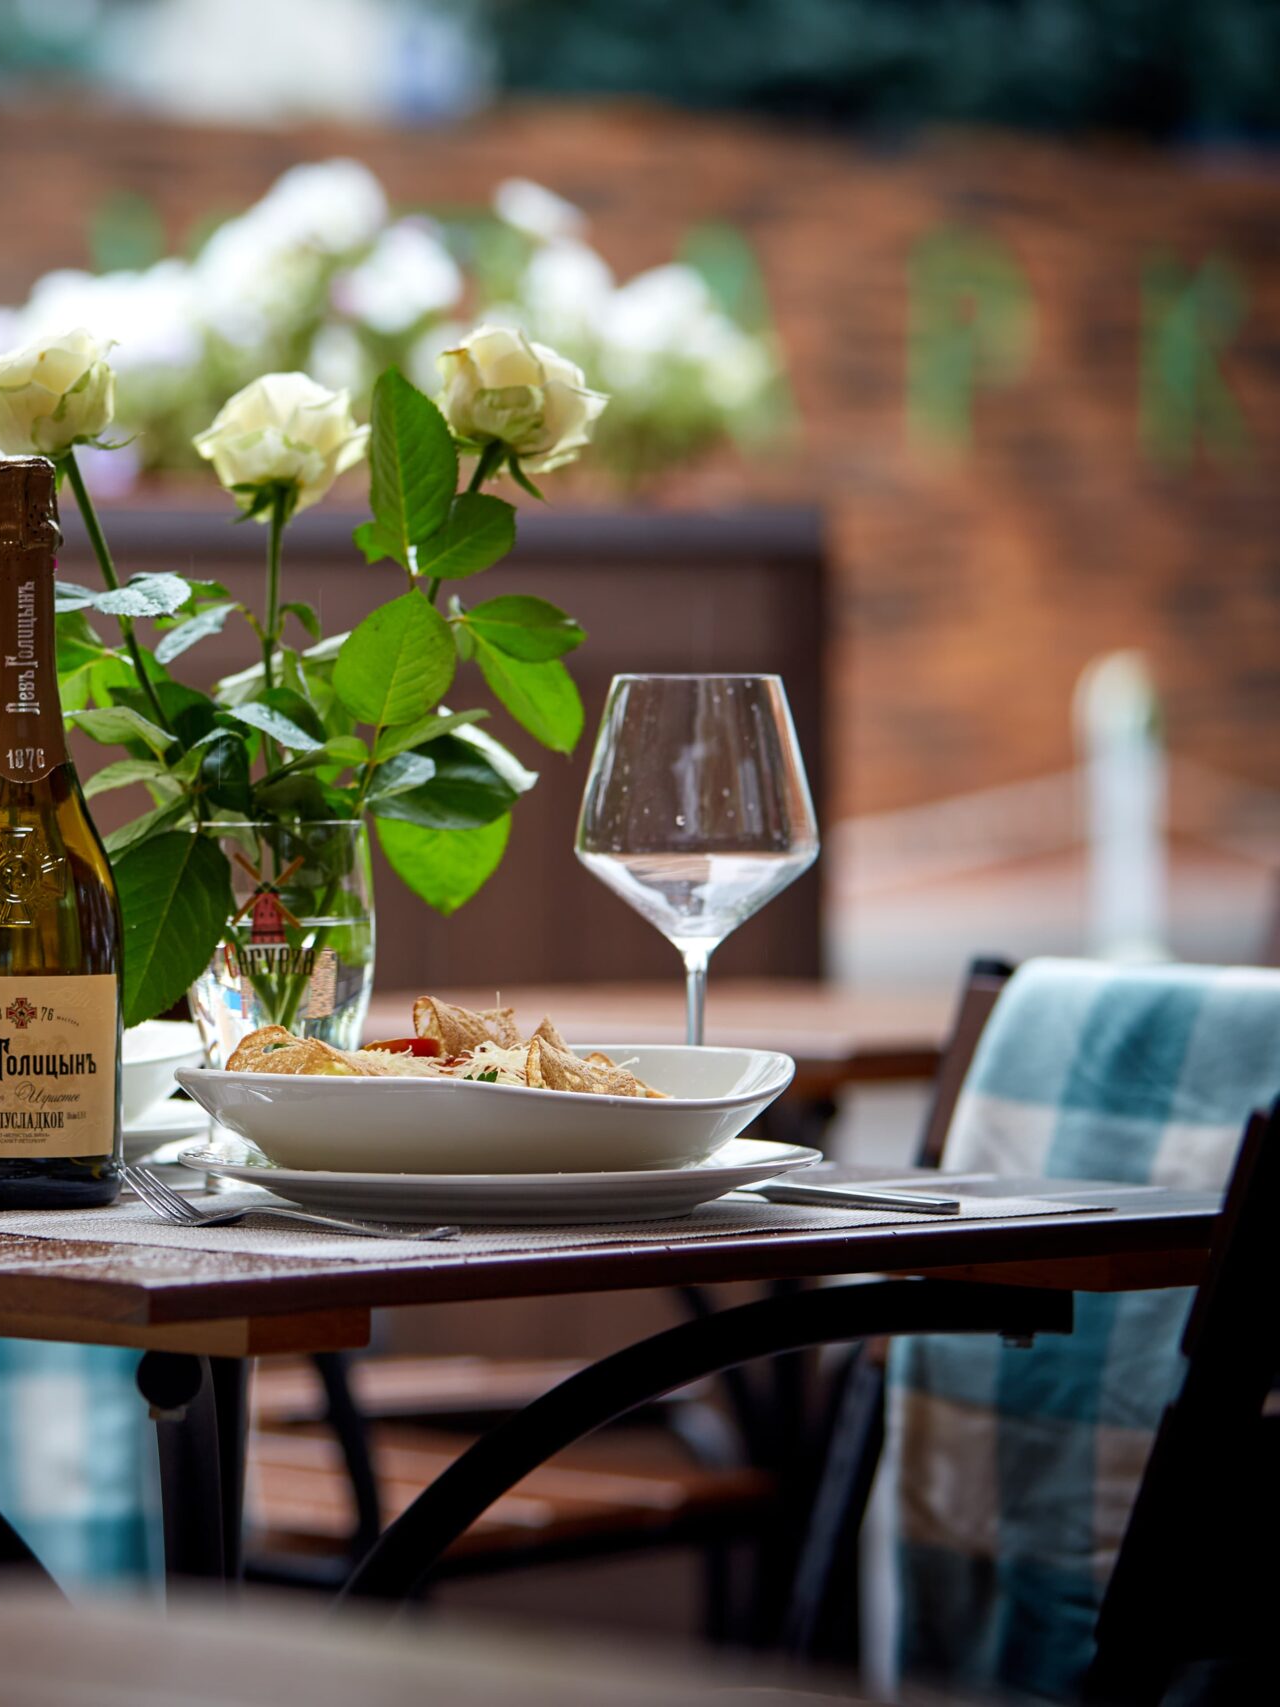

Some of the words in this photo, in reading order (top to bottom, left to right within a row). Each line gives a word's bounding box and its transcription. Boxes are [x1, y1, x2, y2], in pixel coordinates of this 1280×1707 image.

[5, 580, 39, 668] Голицынъ
[6, 670, 41, 715] Левъ
[6, 748, 46, 772] 1876
[41, 1007, 54, 1021] 76
